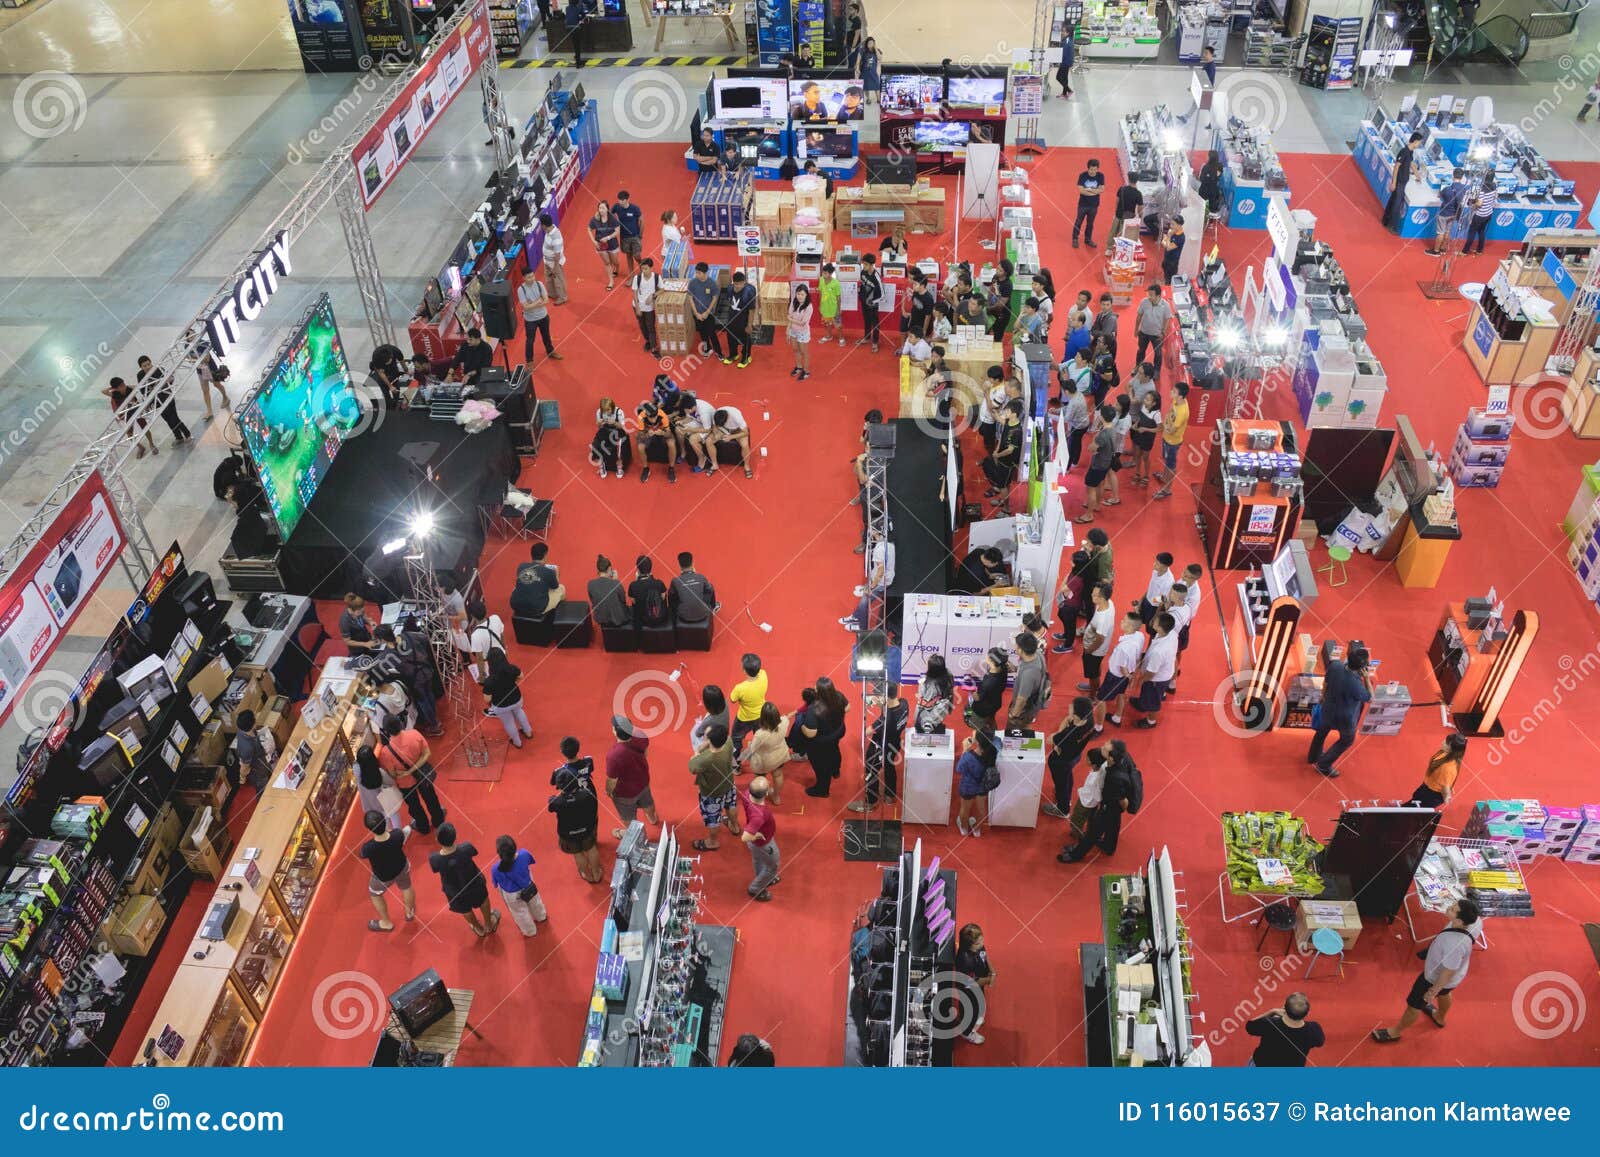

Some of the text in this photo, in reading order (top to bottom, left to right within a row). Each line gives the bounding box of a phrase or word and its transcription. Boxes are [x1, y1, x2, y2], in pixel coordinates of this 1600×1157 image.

[210, 230, 292, 358] IT CITY
[1196, 393, 1210, 424] Canon
[907, 645, 940, 653] EPSON
[951, 646, 984, 654] EPSON
